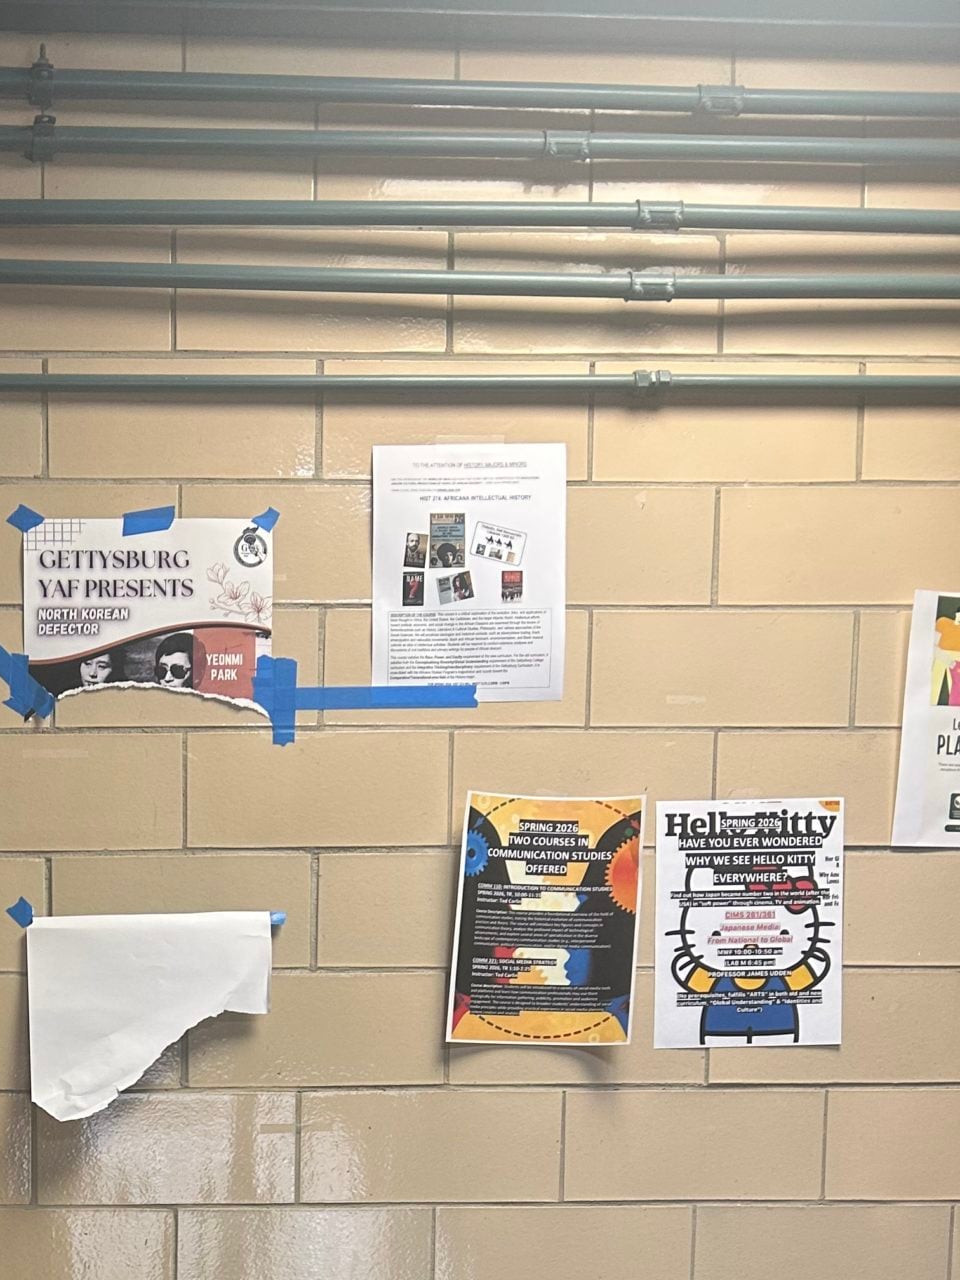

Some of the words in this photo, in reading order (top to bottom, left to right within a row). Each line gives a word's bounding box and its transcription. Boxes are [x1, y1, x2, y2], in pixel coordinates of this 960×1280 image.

[40, 550, 190, 569] GETTYSBURG
[38, 579, 80, 599] YAF
[85, 579, 194, 598] PRESENTS
[38, 608, 77, 620] NORTH
[81, 608, 129, 620] KOREAN
[38, 623, 99, 635] DEFECTOR
[206, 653, 243, 666] YEONMI
[211, 669, 237, 680] PARK
[520, 822, 553, 832] SPRING
[555, 823, 578, 833] 2026
[721, 819, 755, 828] SPRING
[758, 818, 780, 827] 2026
[509, 836, 531, 845] TWO
[532, 837, 575, 846] COURSES
[578, 838, 589, 846] IN
[680, 838, 706, 848] HAVE
[709, 838, 730, 847] YOU
[733, 838, 759, 847] EVER
[762, 836, 823, 847] WONDERED
[488, 848, 569, 859] COMMUNICATION
[572, 851, 612, 860] STUDIES
[686, 856, 711, 866] WHY
[713, 856, 730, 865] WE
[732, 855, 750, 865] SEE
[753, 855, 785, 865] HELLO
[787, 855, 816, 864] KITTY
[526, 864, 567, 874] OFFERED
[714, 873, 788, 883] EVERYWHERE?
[725, 911, 744, 919] CIMS
[720, 924, 755, 932] Japanese
